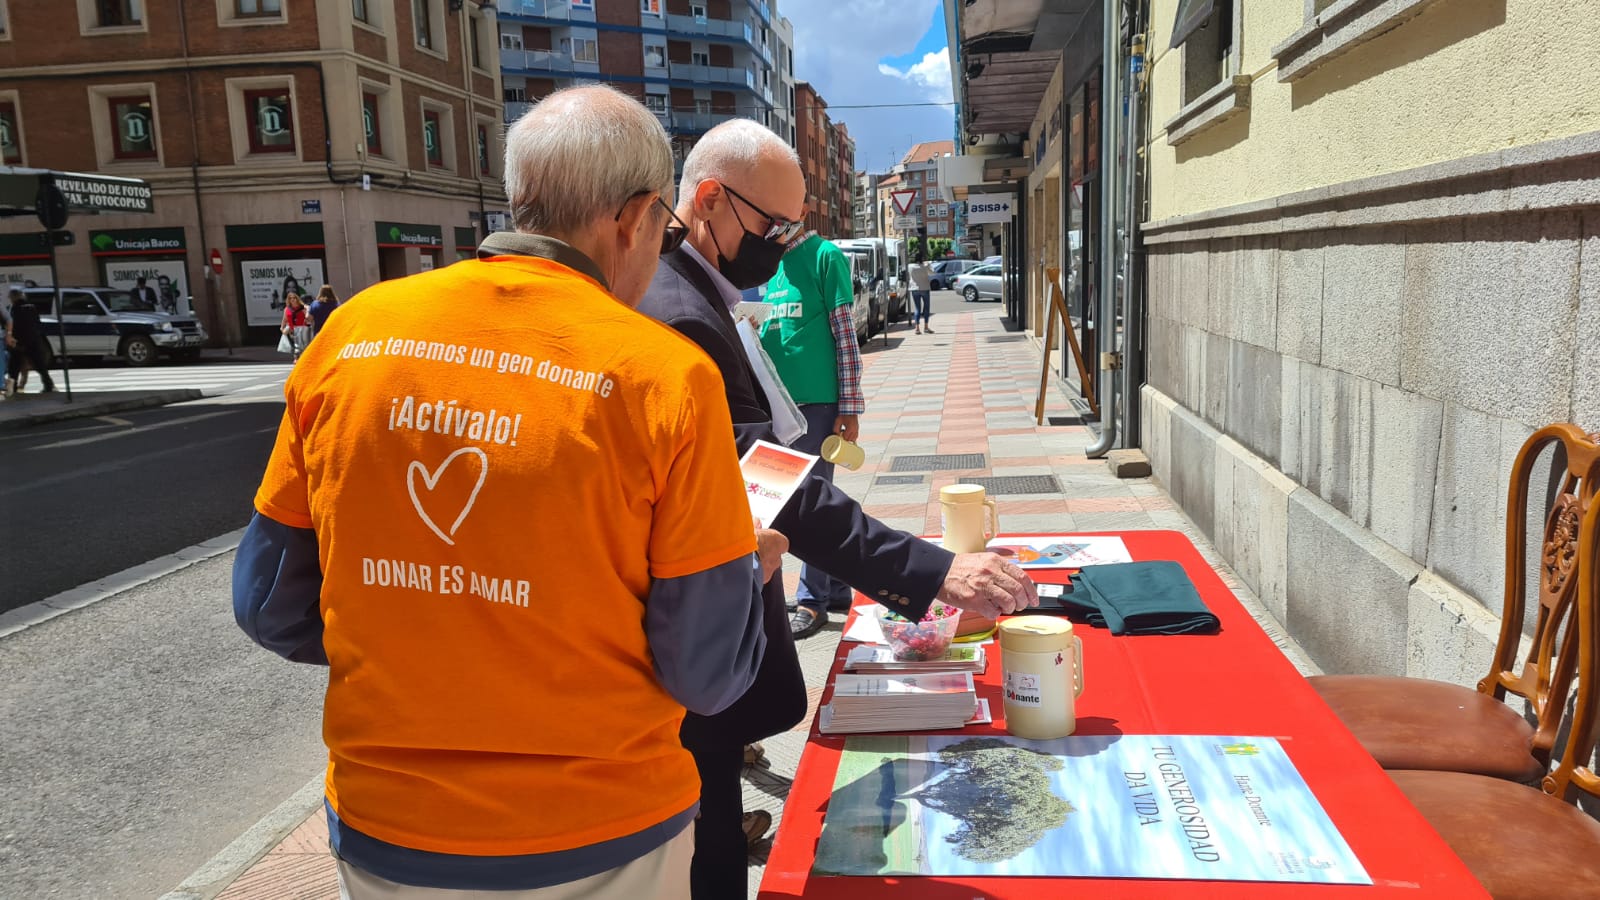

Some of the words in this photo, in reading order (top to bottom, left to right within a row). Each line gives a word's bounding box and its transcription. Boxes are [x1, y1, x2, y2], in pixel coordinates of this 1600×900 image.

[55, 179, 106, 194] REVELADO
[108, 184, 120, 195] DE
[121, 186, 151, 198] FOTOS
[89, 194, 147, 209] FOTOCOPIAS
[384, 336, 467, 364] tenemos
[469, 346, 494, 369] un
[497, 351, 534, 375] gen
[536, 359, 614, 399] donante
[388, 395, 522, 447] ¡Actívalo!
[362, 557, 432, 593] DONAR
[439, 564, 464, 594] ES
[469, 571, 530, 608] AMAR
[1151, 745, 1177, 761] TU
[1124, 772, 1149, 789] DA
[1131, 792, 1163, 826] VIDA
[1158, 763, 1220, 863] GENEROSIDAD
